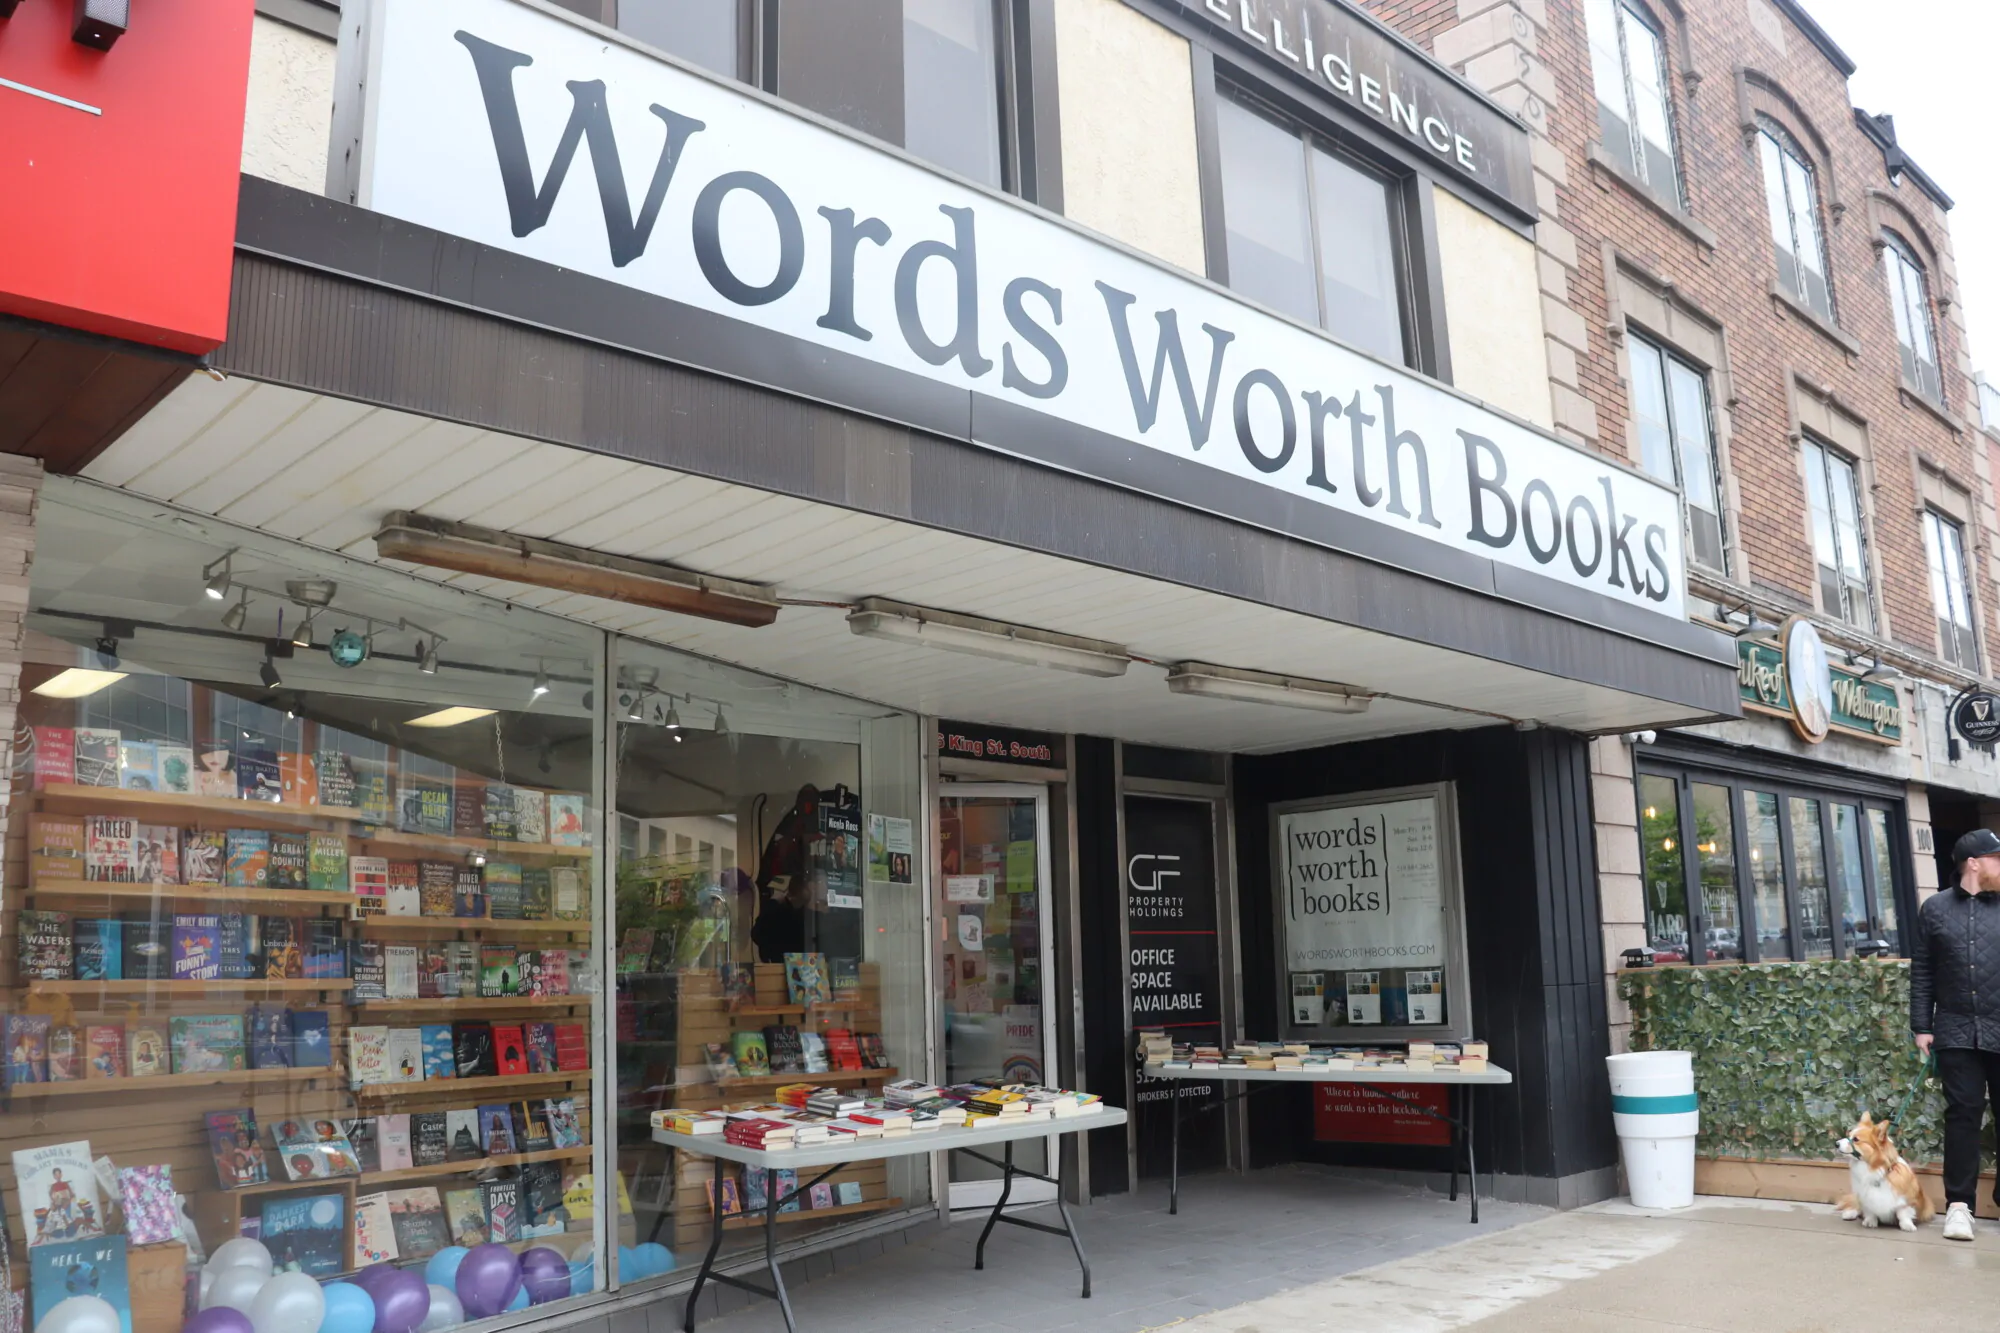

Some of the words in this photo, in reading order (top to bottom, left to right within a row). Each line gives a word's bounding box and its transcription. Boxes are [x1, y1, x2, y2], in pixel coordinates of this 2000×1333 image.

[453, 30, 1068, 399] Words
[1094, 279, 1441, 529] Worth
[1456, 428, 1668, 602] Books
[1738, 648, 1769, 701] uke
[1832, 679, 1902, 733] Wellington
[949, 734, 983, 757] King
[987, 738, 1006, 756] St.
[1010, 742, 1051, 761] South
[421, 790, 448, 803] OCEAN
[40, 823, 80, 836] FAMILY
[93, 820, 132, 839] FAREED
[828, 817, 845, 830] Nicola
[845, 820, 860, 832] Ross
[1295, 817, 1377, 851] words
[1915, 828, 1932, 851] 100
[44, 836, 74, 847] MEAL
[316, 838, 344, 848] LYDIA
[272, 844, 280, 854] A
[281, 844, 305, 856] GREAT
[315, 847, 347, 858] MILLET
[272, 857, 305, 868] COUNTRY
[1297, 849, 1379, 883] worth
[388, 863, 418, 877] EEKING
[459, 873, 480, 884] RIVER
[1130, 896, 1184, 907] PROPERTY
[1300, 883, 1381, 915] books
[1130, 908, 1184, 918] HOLDINGS
[38, 922, 61, 935] THE
[175, 916, 197, 928] EMILY
[198, 916, 219, 929] HENRY
[26, 935, 71, 946] WATERS
[386, 949, 416, 957] TREMOR
[1131, 948, 1175, 966] OFFICE
[1296, 945, 1435, 960] WORDSWORTHBOOKS.COM
[175, 953, 206, 974] FUNNY
[517, 953, 532, 967] HUT
[189, 963, 220, 981] STORY
[481, 979, 500, 988] WILL
[1131, 972, 1172, 989] SPACE
[482, 988, 501, 997] RUIN
[1133, 993, 1203, 1013] AVAILABLE
[354, 1032, 375, 1043] Never
[1005, 1025, 1035, 1038] PRIDE
[528, 1034, 548, 1045] Drag
[362, 1044, 384, 1056] Been
[356, 1057, 381, 1070] Better
[1137, 1090, 1169, 1102] BROKERS
[1170, 1086, 1213, 1100] POTECTED
[1353, 1086, 1360, 1098] is
[1324, 1104, 1332, 1112] so
[1334, 1102, 1354, 1113] weak
[1356, 1105, 1366, 1114] as
[1368, 1102, 1376, 1113] in
[421, 1122, 446, 1132] Caste
[490, 1191, 517, 1210] DAYS
[270, 1201, 310, 1220] DARKEST
[274, 1213, 306, 1232] DARK
[51, 1252, 82, 1268] HERE
[96, 1249, 113, 1261] WE
